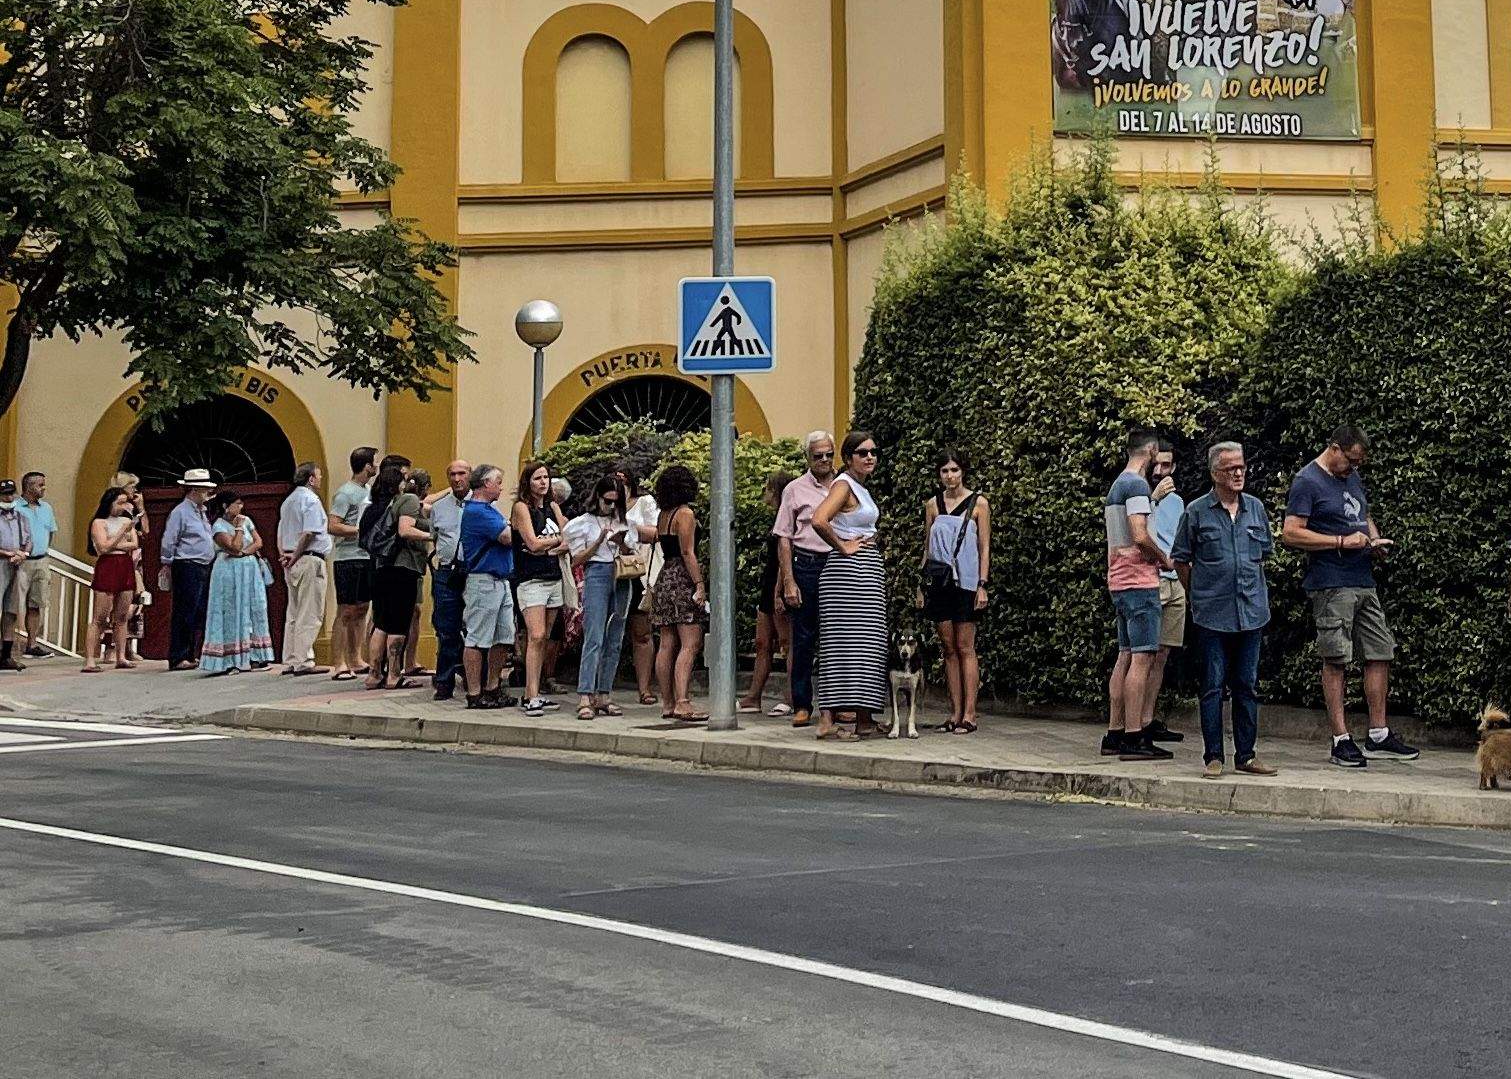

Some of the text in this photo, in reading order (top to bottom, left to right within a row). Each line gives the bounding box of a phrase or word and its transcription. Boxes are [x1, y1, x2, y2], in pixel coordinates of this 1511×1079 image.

[1087, 13, 1325, 80] SAN LORENZO!
[1092, 66, 1328, 108] ¡VOLVEMOS A LO GRANDE!
[1119, 110, 1301, 136] DEL 7 AL 14 DE AGOSTO
[579, 350, 664, 387] PUERTA
[244, 376, 280, 404] BIS
